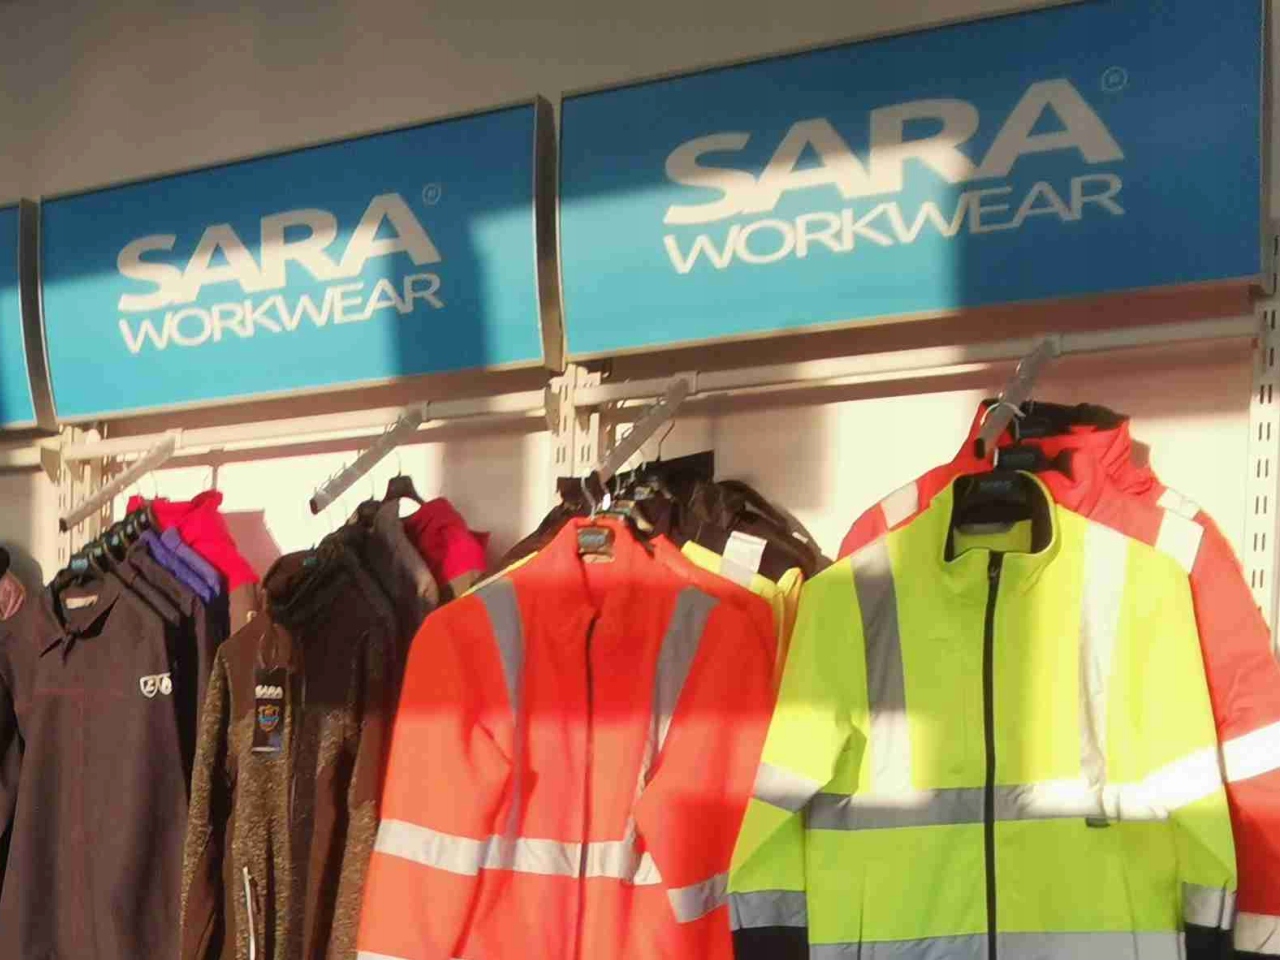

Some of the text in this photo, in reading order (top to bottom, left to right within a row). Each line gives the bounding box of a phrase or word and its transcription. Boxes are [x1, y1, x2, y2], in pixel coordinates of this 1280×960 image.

[663, 78, 1124, 225] SARA
[117, 192, 443, 312] SARA
[663, 174, 1125, 275] WORKWEAR
[120, 273, 445, 355] WORKWEAR
